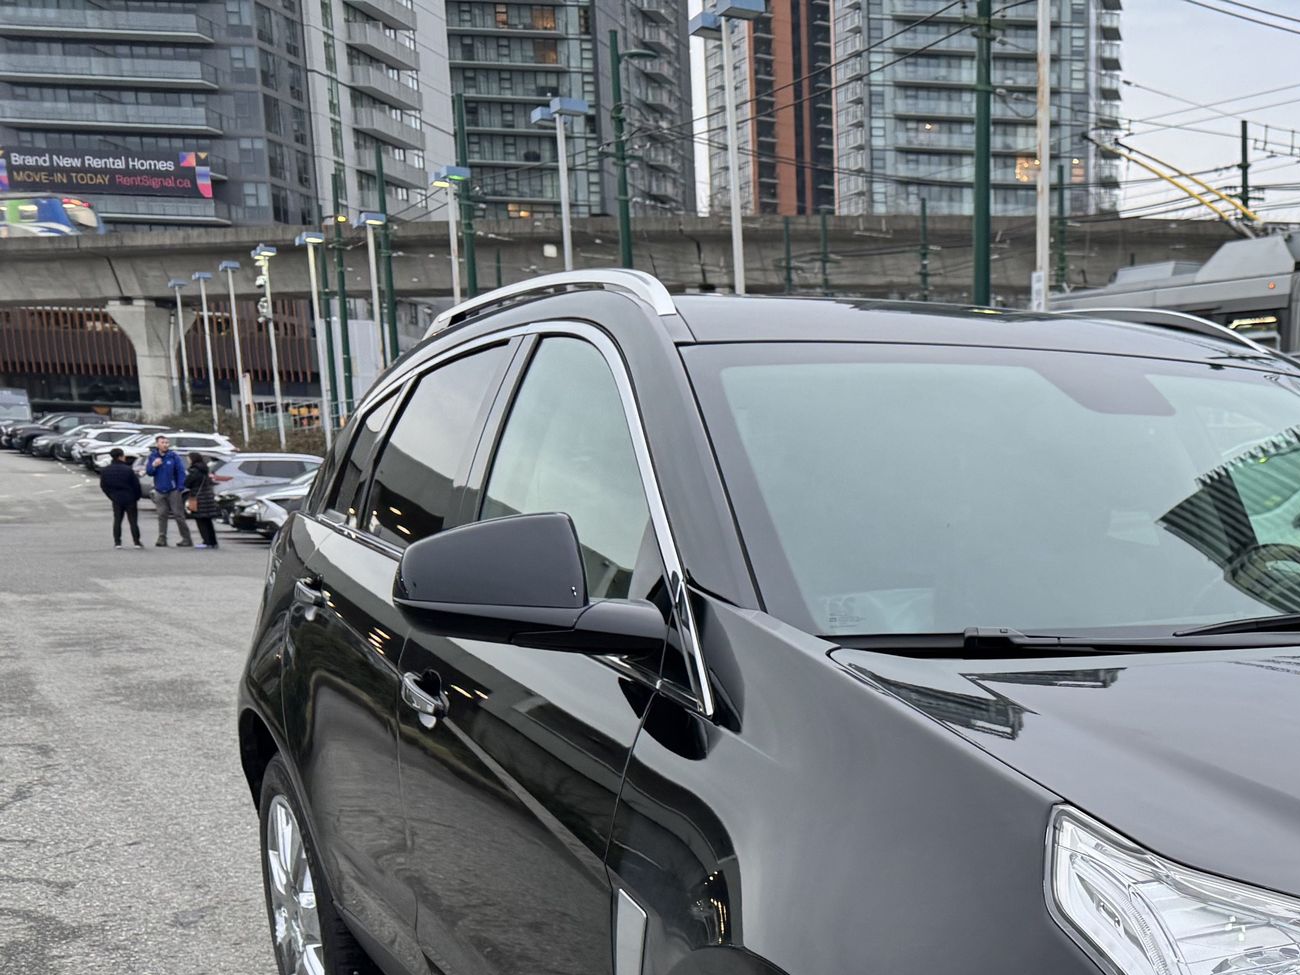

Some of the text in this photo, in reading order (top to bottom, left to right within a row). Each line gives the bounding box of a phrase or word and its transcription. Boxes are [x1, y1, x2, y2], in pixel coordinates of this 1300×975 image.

[10, 153, 175, 171] Brand New Rental Homes
[13, 171, 192, 188] MOVE-IN TODAY RentSignal.ca
